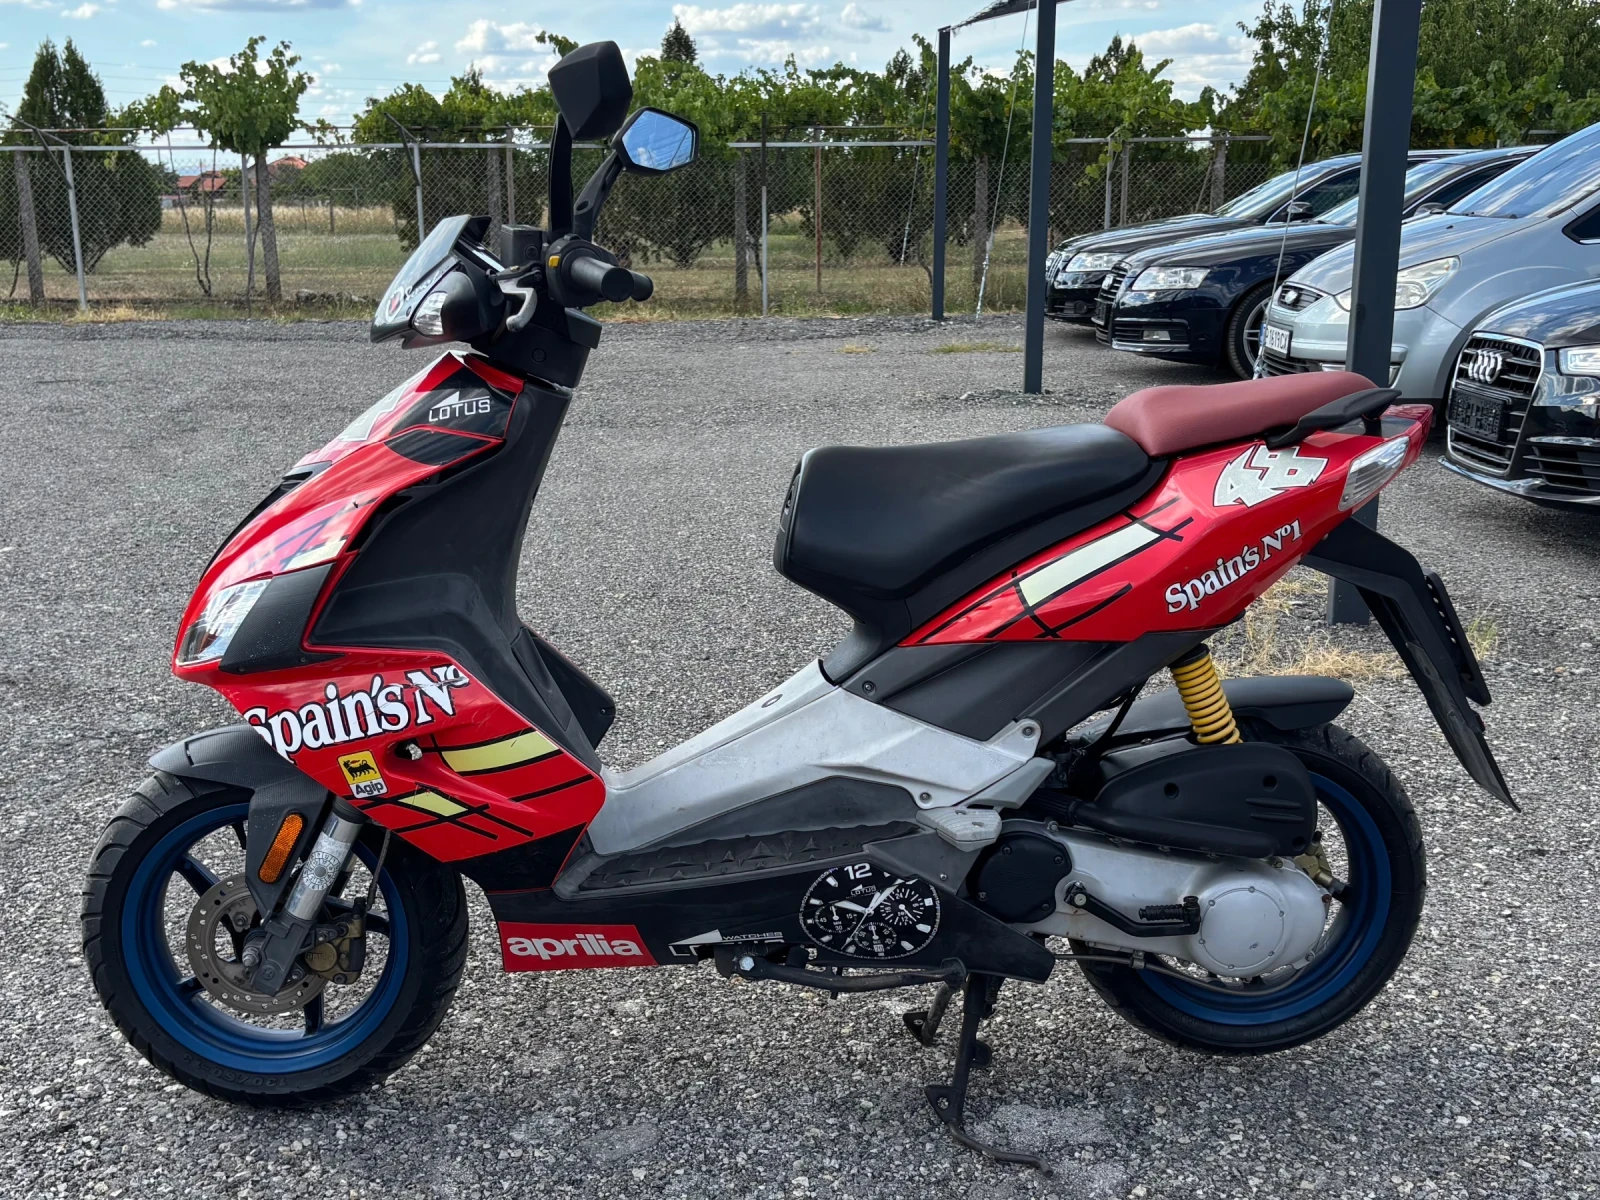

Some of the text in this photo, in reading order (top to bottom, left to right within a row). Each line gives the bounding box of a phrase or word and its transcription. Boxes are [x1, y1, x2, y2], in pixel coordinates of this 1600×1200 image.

[428, 398, 491, 423] LOTUS
[1165, 545, 1260, 613] Spain's
[243, 674, 410, 764] Spain's
[355, 778, 386, 798] Agip
[844, 862, 873, 880] 12
[850, 885, 877, 896] LOTUS
[505, 932, 643, 961] aprilia
[723, 931, 783, 941] WATCHES
